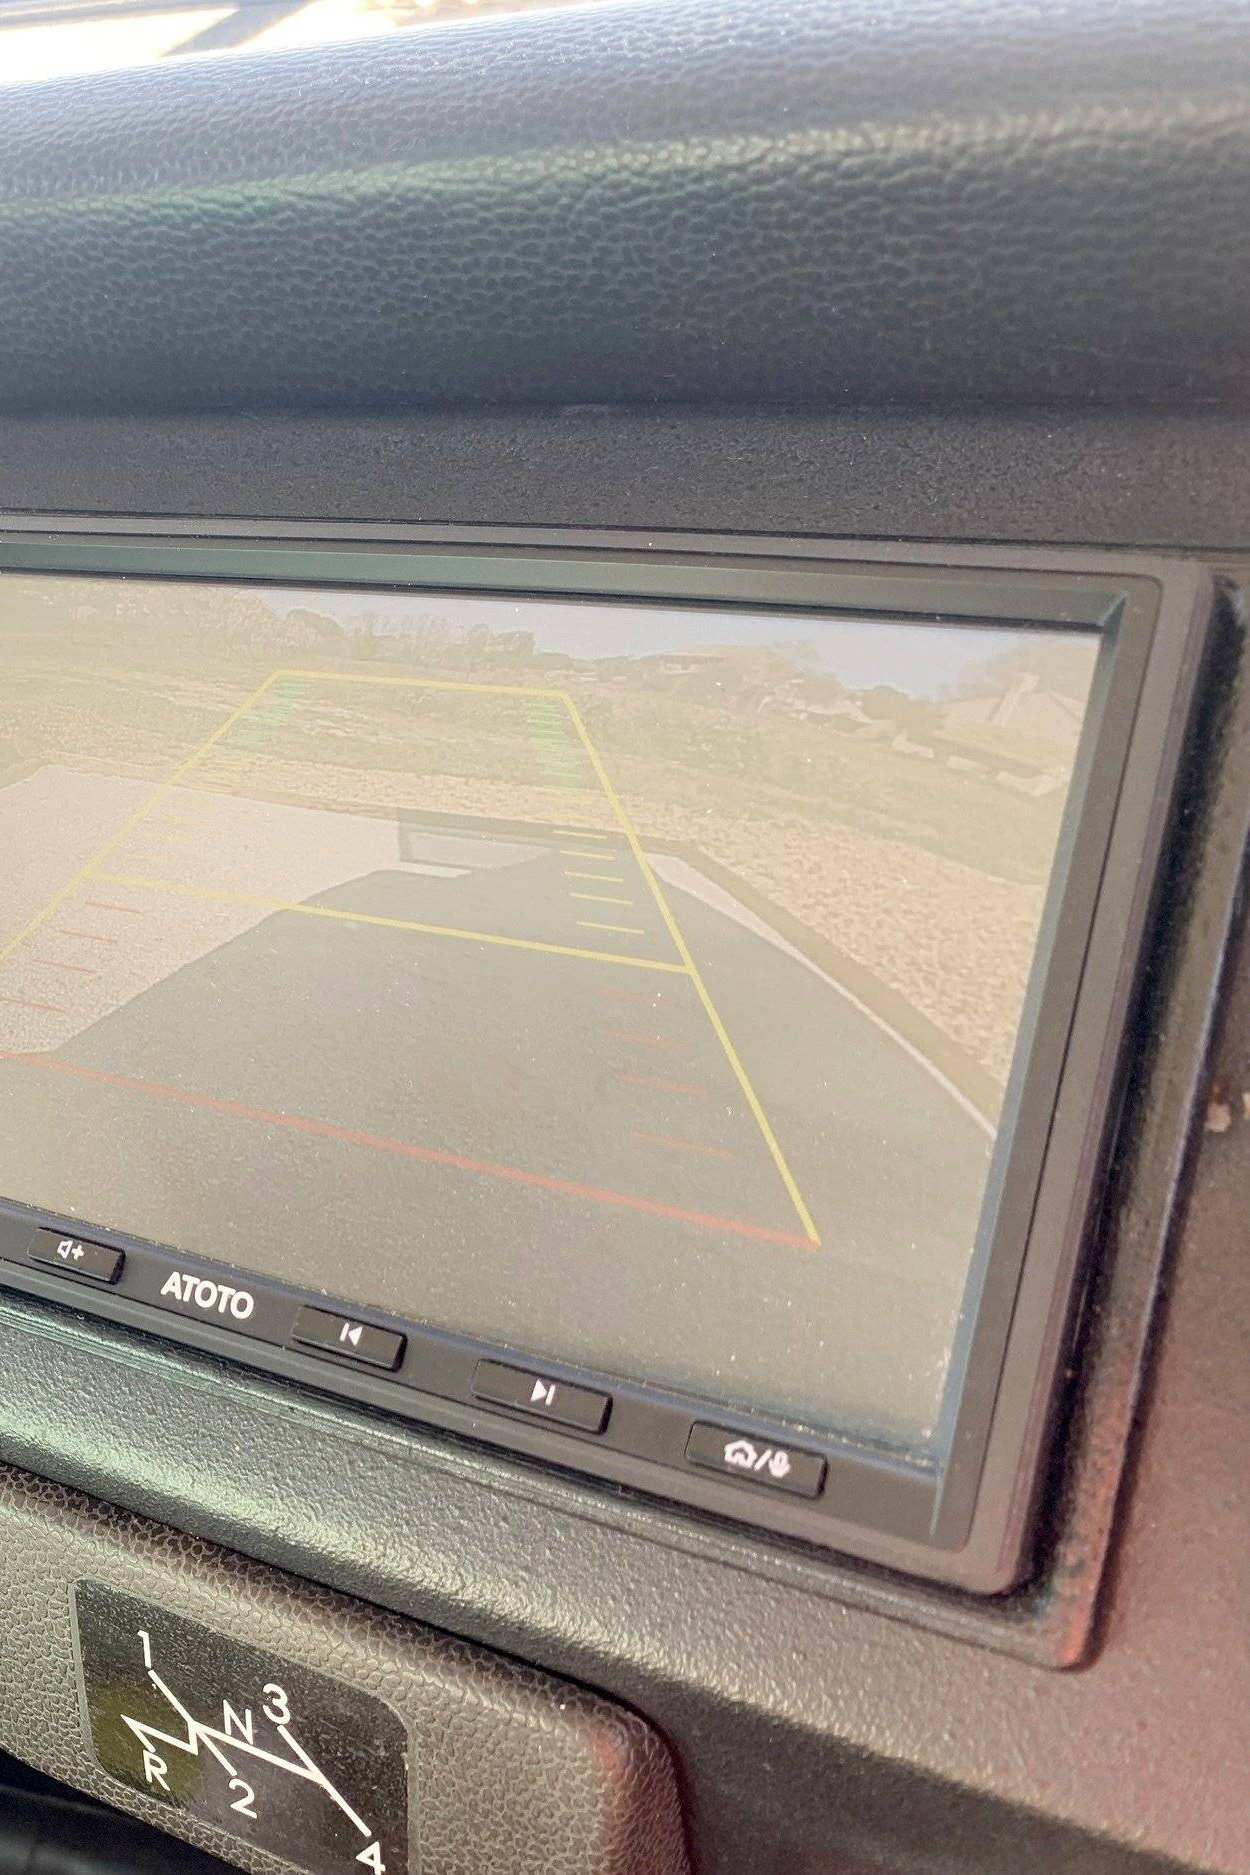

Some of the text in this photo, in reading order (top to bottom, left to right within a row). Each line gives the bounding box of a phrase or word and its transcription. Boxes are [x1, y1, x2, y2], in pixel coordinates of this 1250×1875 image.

[160, 1271, 255, 1319] ATOTO
[137, 1629, 152, 1668] 1
[222, 1699, 254, 1745] N
[262, 1683, 291, 1725] 3
[142, 1749, 171, 1791] R
[228, 1778, 258, 1819] 2
[355, 1841, 386, 1875] 4
